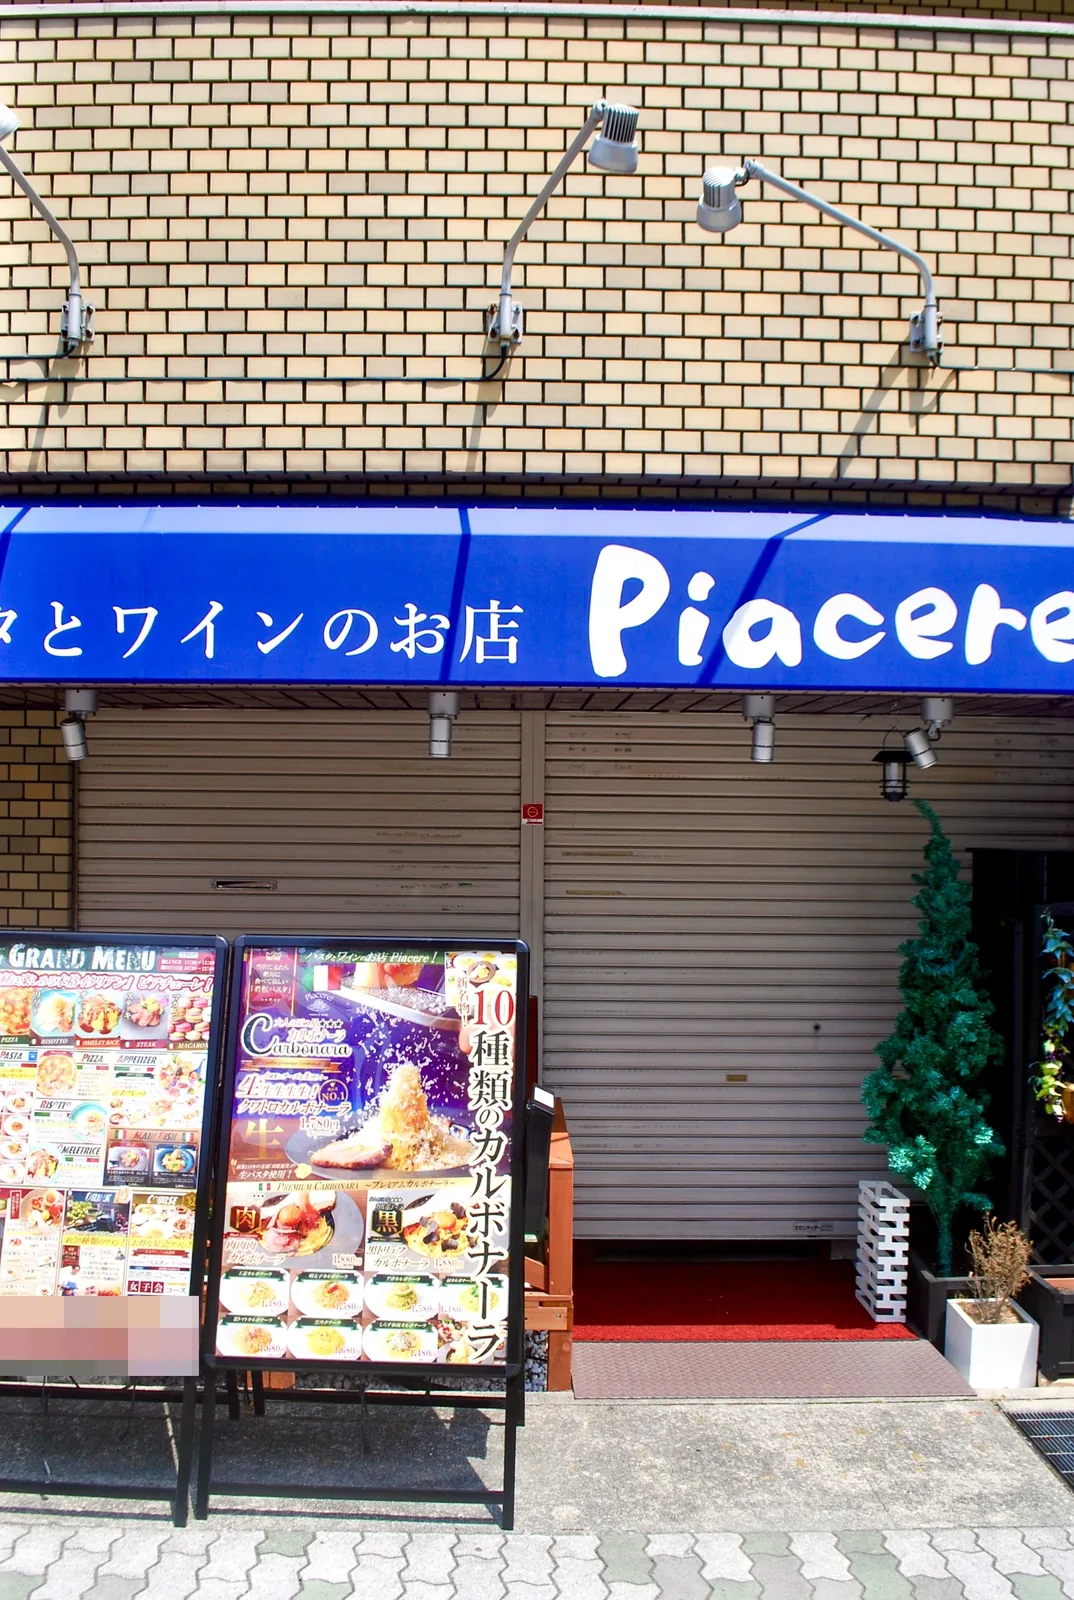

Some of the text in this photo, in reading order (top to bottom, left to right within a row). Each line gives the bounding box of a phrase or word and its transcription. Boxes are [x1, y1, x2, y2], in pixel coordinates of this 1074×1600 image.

[588, 544, 1074, 678] Piacere
[8, 943, 156, 971] GRAND MENU
[305, 951, 387, 963] パスタとワインのお店
[243, 1015, 351, 1055] Carbonara
[0, 1051, 23, 1060] PASTA
[81, 1054, 104, 1063] PIZZA
[117, 1055, 157, 1064] APPETIZER
[322, 1091, 345, 1102] NO.1
[40, 1100, 71, 1110] RISOTTO
[238, 1098, 351, 1116] クワトロカルボナーラ
[244, 1118, 284, 1160] 生
[57, 1144, 101, 1155] OMELETRICE
[277, 1182, 313, 1191] PREMIUM
[314, 1182, 359, 1191] CARBONARA
[85, 1193, 112, 1203] DRINK
[147, 1195, 178, 1205] COURSE
[236, 1207, 257, 1229] 肉
[376, 1210, 399, 1233] 黒
[129, 1282, 163, 1292] 女子会
